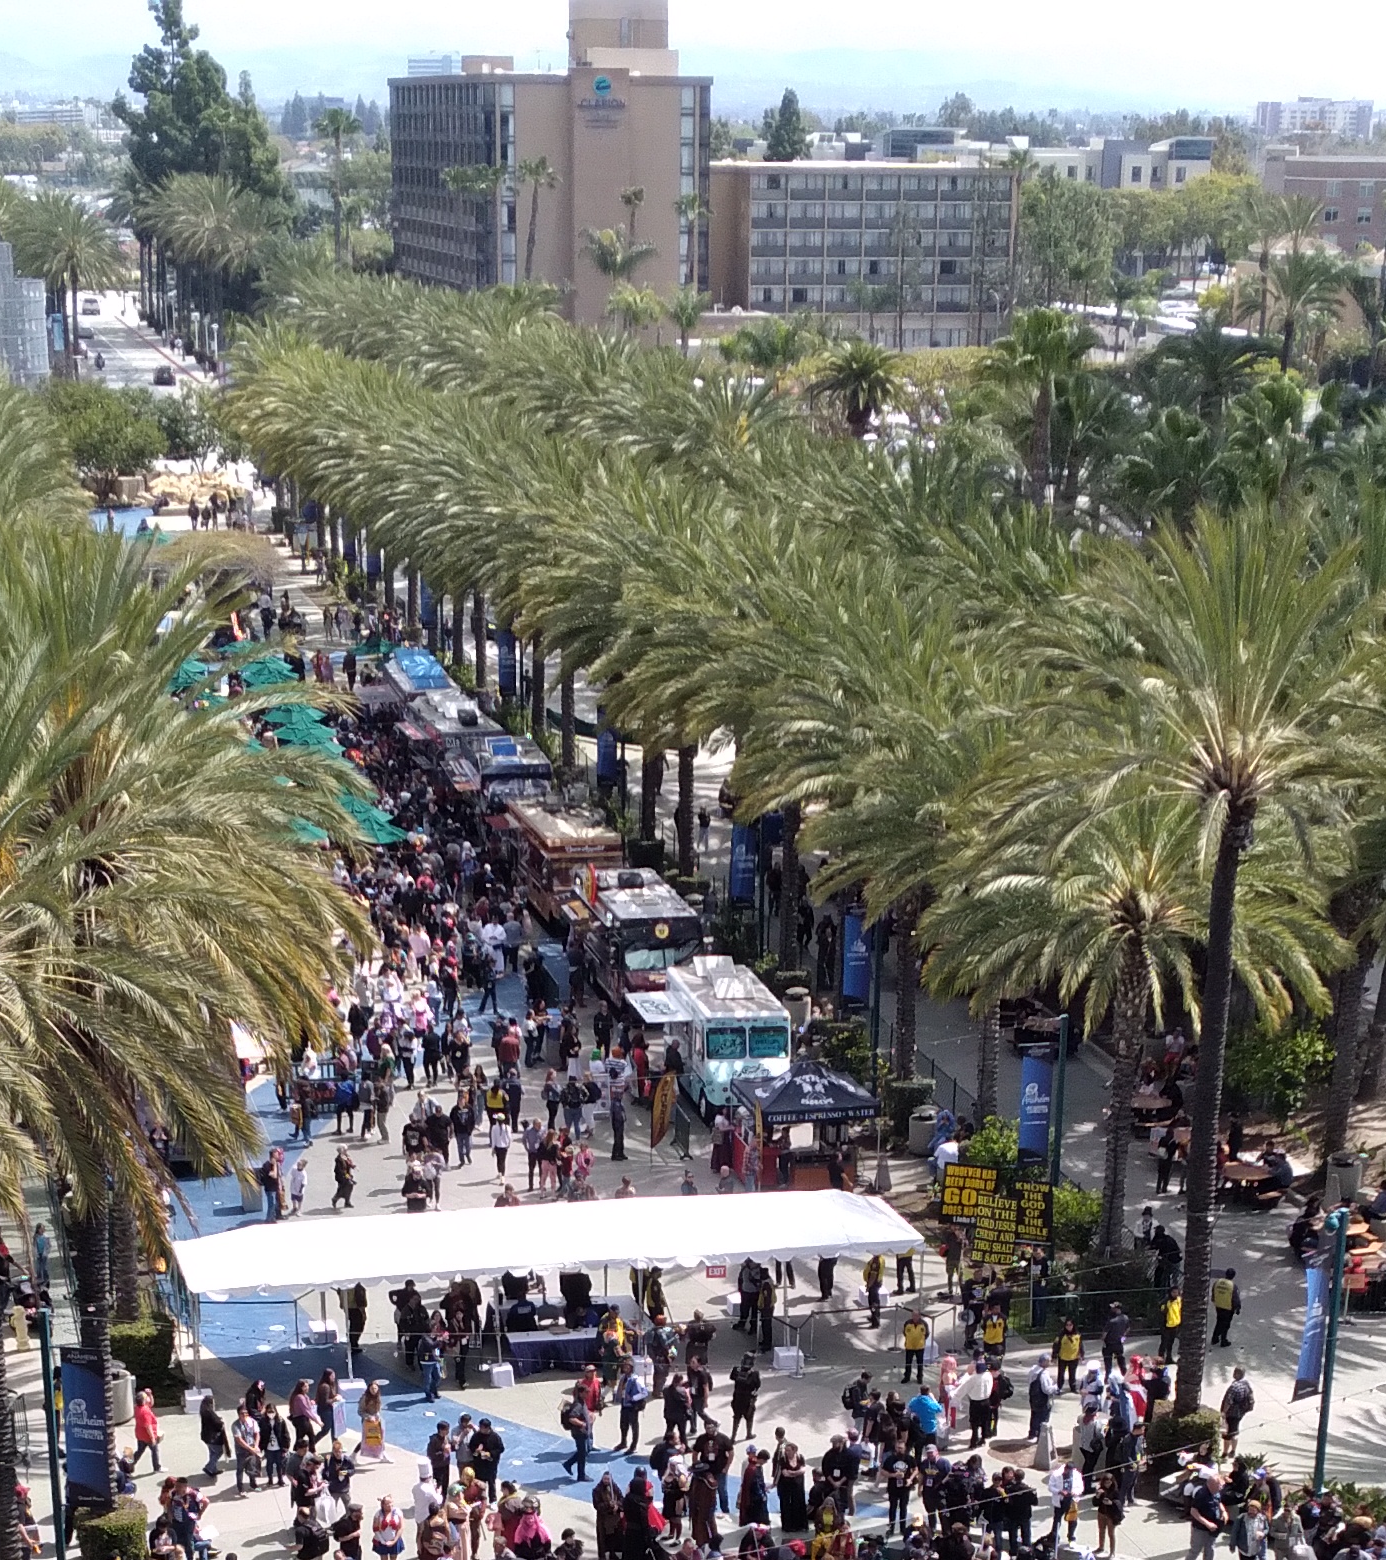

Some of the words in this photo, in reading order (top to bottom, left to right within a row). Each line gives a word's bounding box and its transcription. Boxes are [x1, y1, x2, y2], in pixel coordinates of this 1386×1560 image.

[768, 1113, 798, 1122] COFFEE
[804, 1110, 842, 1120] ESPRESSO
[848, 1108, 875, 1117] WATER
[946, 1164, 982, 1178] WHOEVER
[982, 1168, 997, 1180] HAS
[945, 1175, 964, 1188] BEEN
[964, 1177, 986, 1190] BORN
[986, 1180, 996, 1191] OF
[1015, 1181, 1050, 1193] KNOW
[944, 1187, 978, 1206] GO
[978, 1195, 1017, 1210] BELIEVE
[1023, 1191, 1043, 1201] THE
[942, 1205, 963, 1215] DOES
[1020, 1201, 1046, 1210] GOD
[977, 1206, 992, 1218] ON
[994, 1209, 1017, 1221] THE
[1025, 1209, 1040, 1218] OF
[977, 1216, 994, 1228] LORD
[994, 1220, 1016, 1232] JESUS
[1024, 1217, 1044, 1227] THE
[975, 1228, 998, 1240] CHRIST
[999, 1232, 1015, 1242] AND
[1017, 1225, 1048, 1236] BIBLE
[974, 1239, 992, 1250] THOU
[992, 1242, 1014, 1253] SHALT
[971, 1250, 983, 1261] BE
[984, 1254, 1013, 1264] SAVED
[709, 1267, 725, 1276] EXIT
